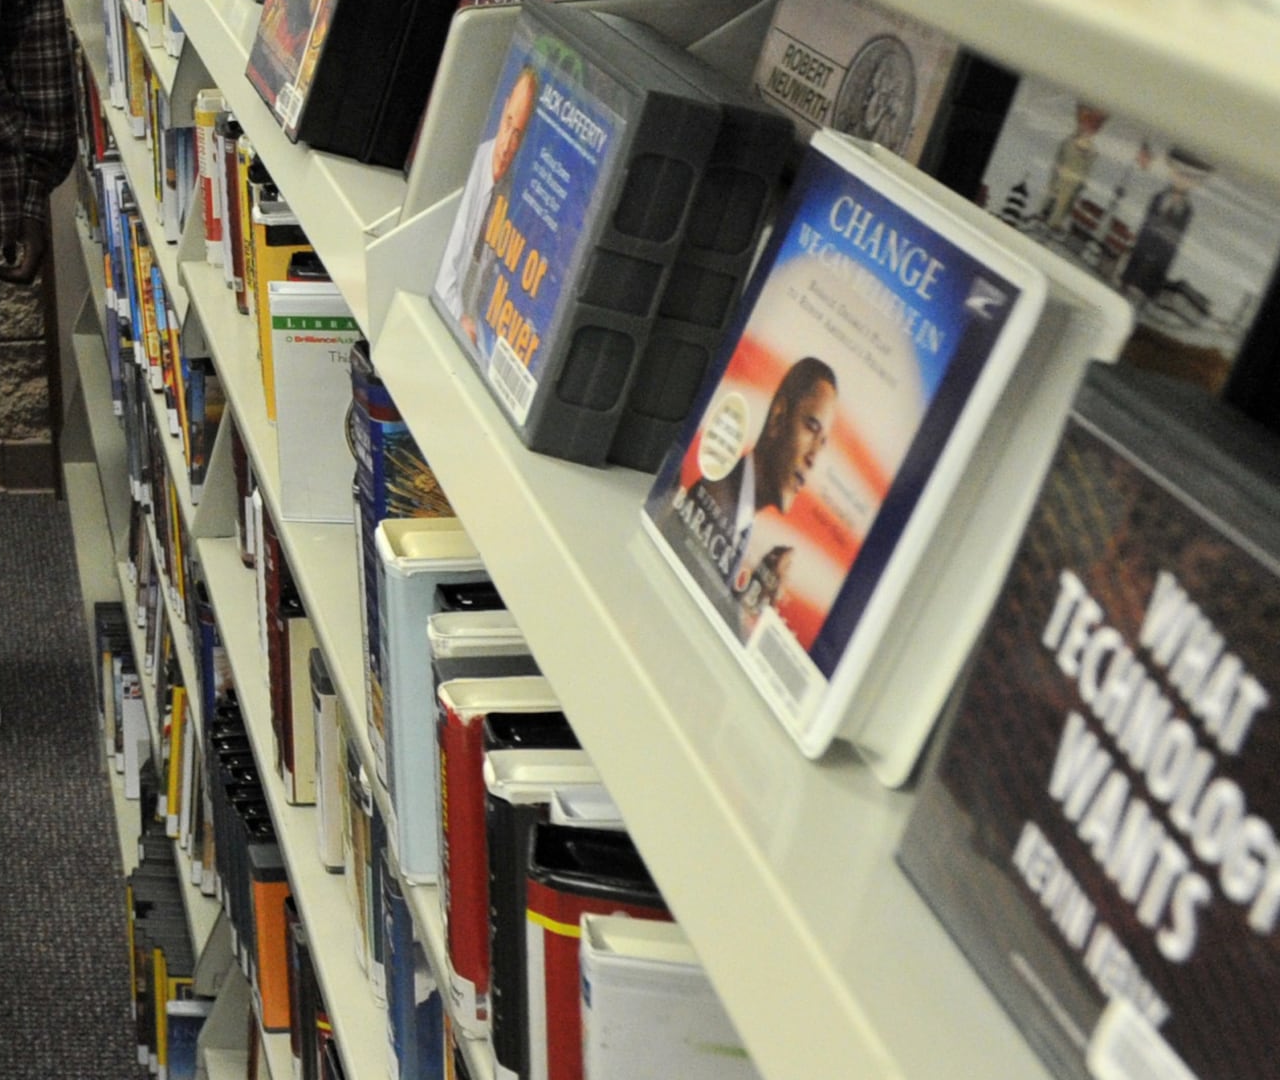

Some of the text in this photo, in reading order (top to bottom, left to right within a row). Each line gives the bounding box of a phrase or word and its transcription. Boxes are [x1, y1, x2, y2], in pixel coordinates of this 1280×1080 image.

[766, 69, 833, 120] NEUWIRTH
[782, 42, 836, 89] ROBERT
[539, 82, 608, 154] JACK CAFFERTY
[484, 195, 526, 274] Now
[522, 251, 549, 299] or
[798, 221, 824, 256] WE
[914, 318, 946, 355] IN
[829, 194, 945, 302] CHANGE
[485, 274, 540, 367] Never
[672, 484, 733, 577] BARACK
[1141, 570, 1270, 756] WHAT
[1012, 820, 1098, 951] KEVIN
[1047, 710, 1213, 963] WANTS
